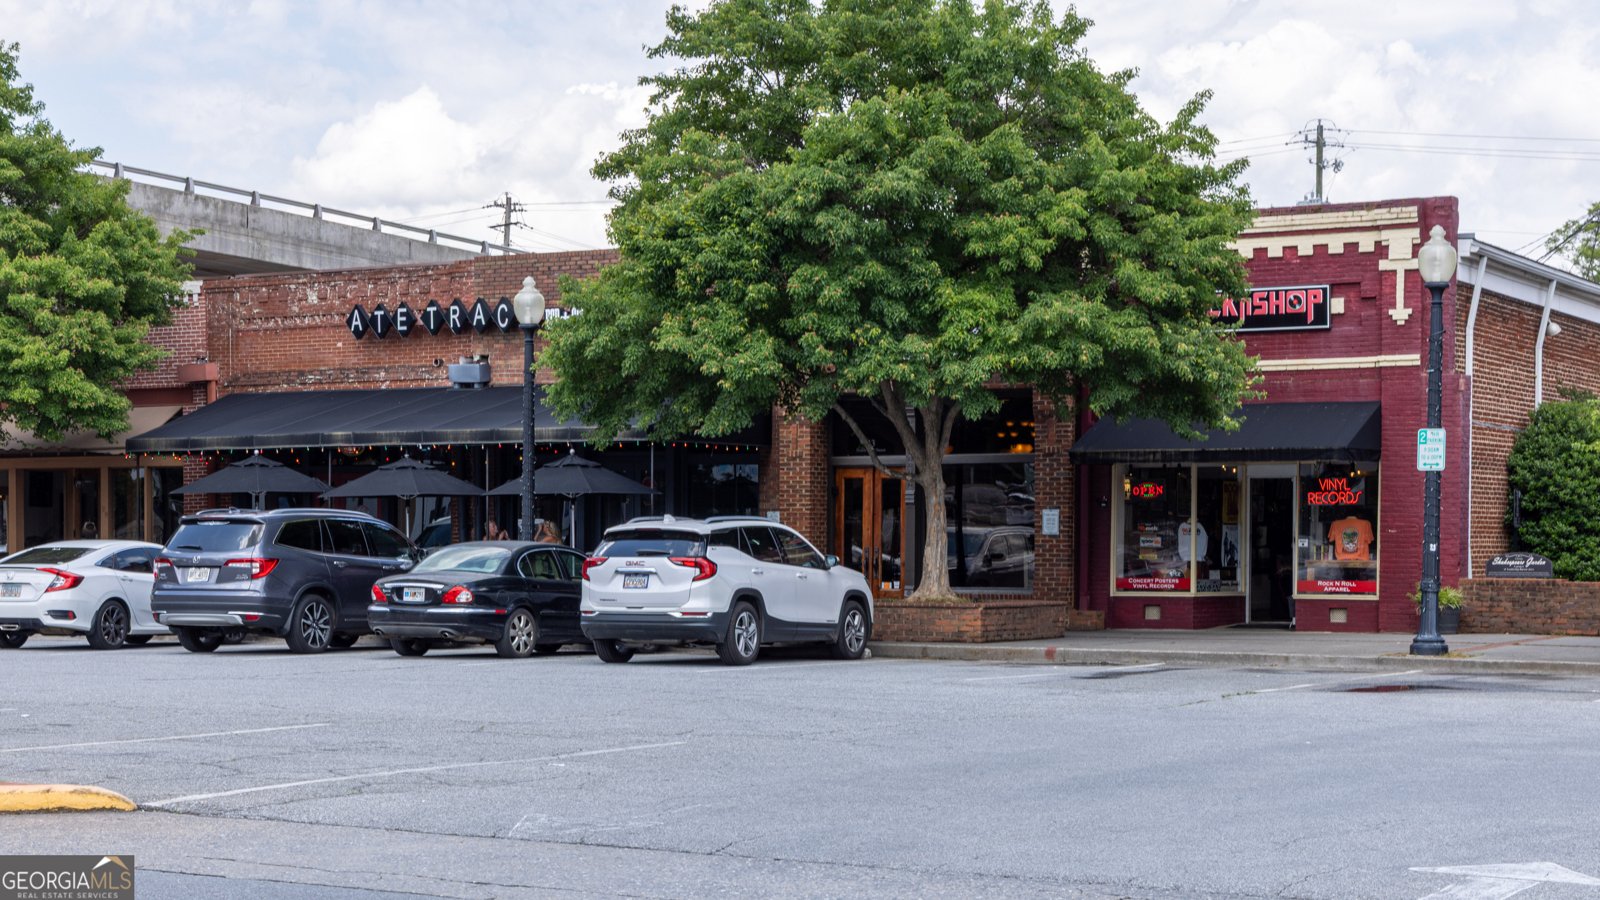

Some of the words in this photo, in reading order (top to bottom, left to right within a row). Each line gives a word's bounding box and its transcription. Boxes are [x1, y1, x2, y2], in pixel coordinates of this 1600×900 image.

[427, 303, 509, 330] TRAC
[1420, 431, 1426, 443] 2
[1132, 485, 1163, 496] OPEN
[1319, 479, 1351, 491] VINYL
[1307, 491, 1363, 505] RECORDS
[1525, 556, 1546, 568] Garden
